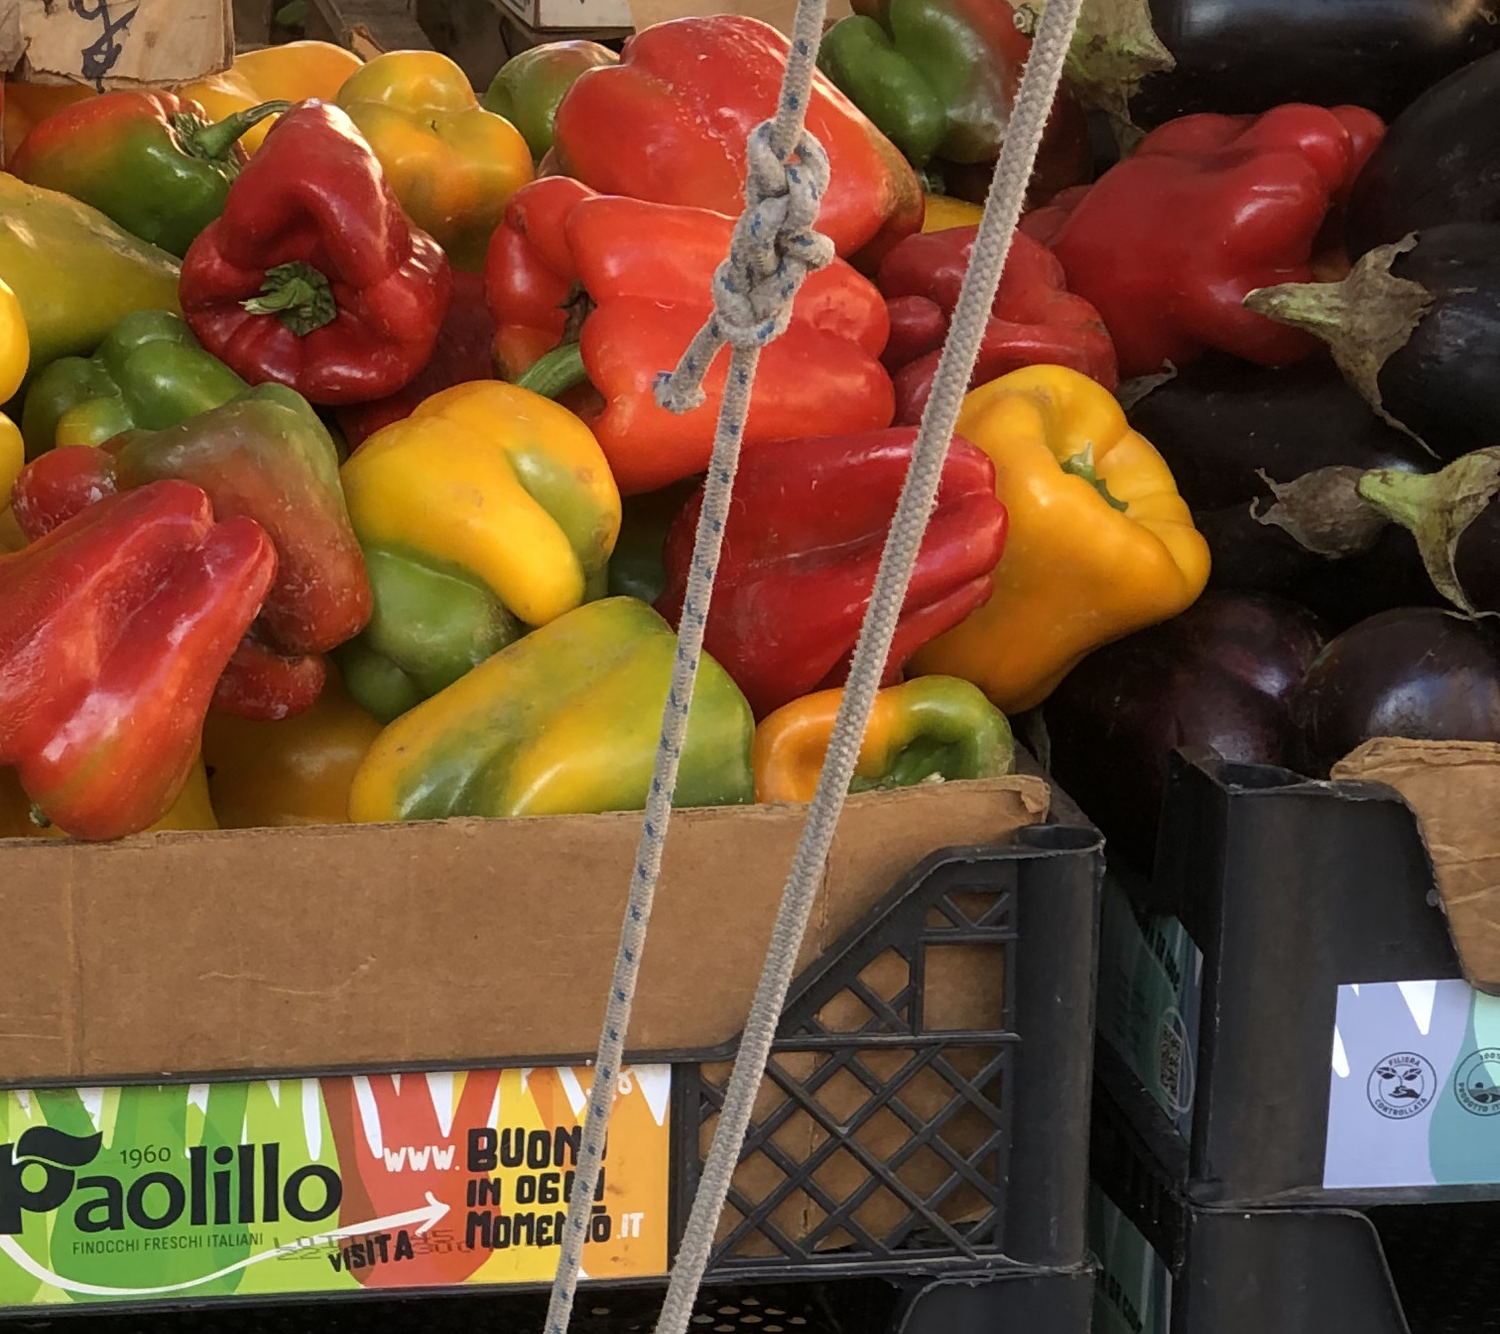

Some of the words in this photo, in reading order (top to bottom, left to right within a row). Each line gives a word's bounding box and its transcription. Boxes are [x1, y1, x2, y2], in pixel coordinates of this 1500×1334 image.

[1388, 1056, 1421, 1067] FILIERA
[1374, 1097, 1428, 1116] CONTROLLATA
[119, 1145, 172, 1169] 1960
[467, 1125, 608, 1173] BUON
[466, 1177, 502, 1208] IN
[72, 1238, 140, 1255] FINOCCHI
[143, 1235, 202, 1253] FRESCHI
[206, 1232, 264, 1249] ITALIANI
[328, 1231, 414, 1273] VISITA
